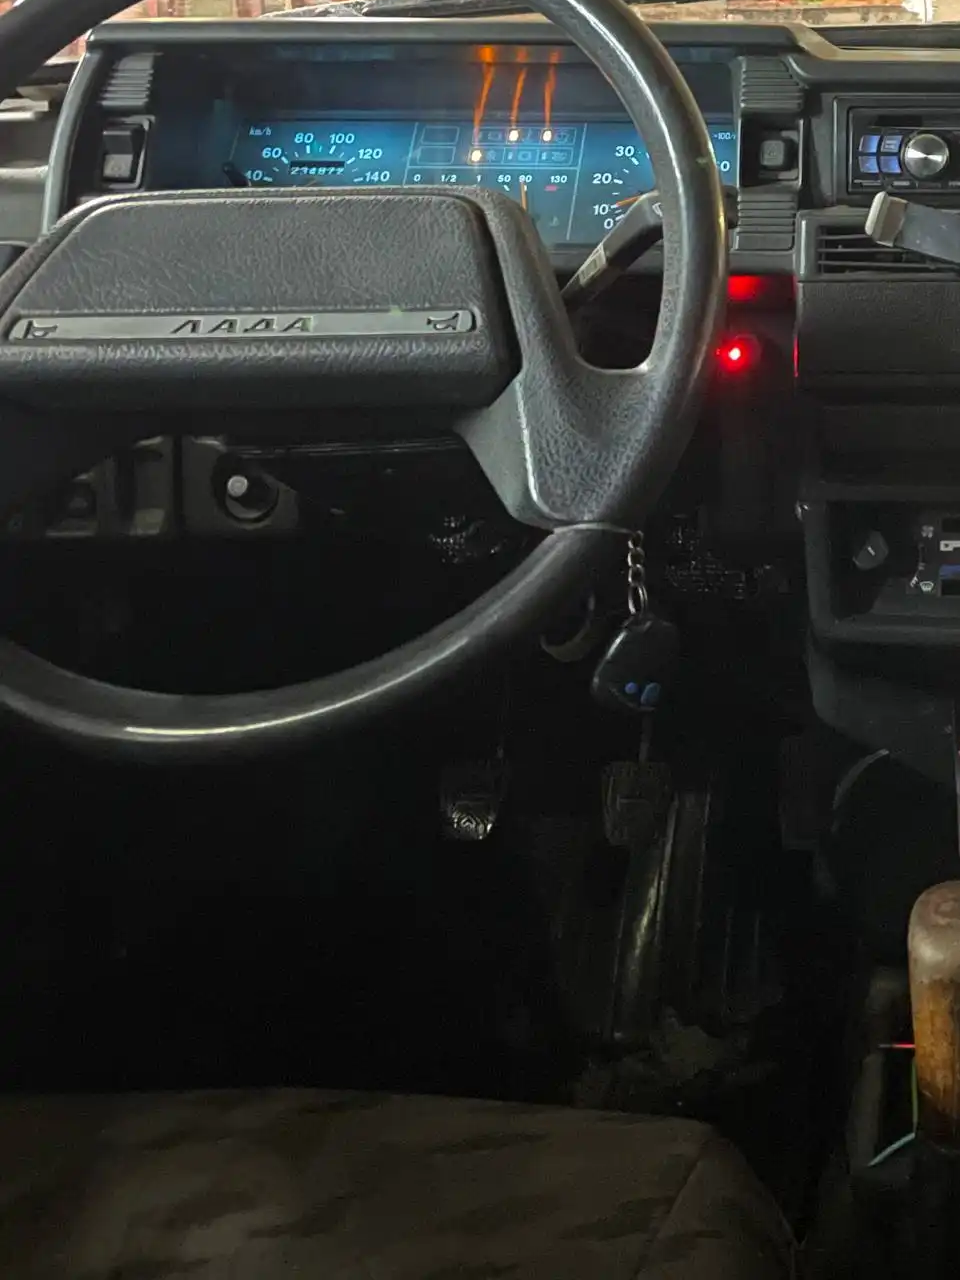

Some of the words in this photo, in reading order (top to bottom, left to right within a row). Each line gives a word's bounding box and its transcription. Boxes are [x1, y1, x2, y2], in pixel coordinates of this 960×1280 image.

[294, 132, 314, 144] 80
[329, 133, 355, 144] 100
[261, 147, 282, 159] 60
[358, 148, 383, 160] 120
[615, 145, 635, 157] 30
[365, 170, 391, 182] 140
[413, 173, 421, 182] 0
[440, 174, 457, 183] 1/2
[476, 174, 482, 183] 1
[497, 174, 512, 183] 50
[518, 174, 533, 183] 90
[550, 174, 568, 183] 130
[592, 172, 612, 184] 20
[593, 204, 609, 215] 10
[603, 218, 614, 229] 0
[171, 316, 313, 335] ЛАДА
